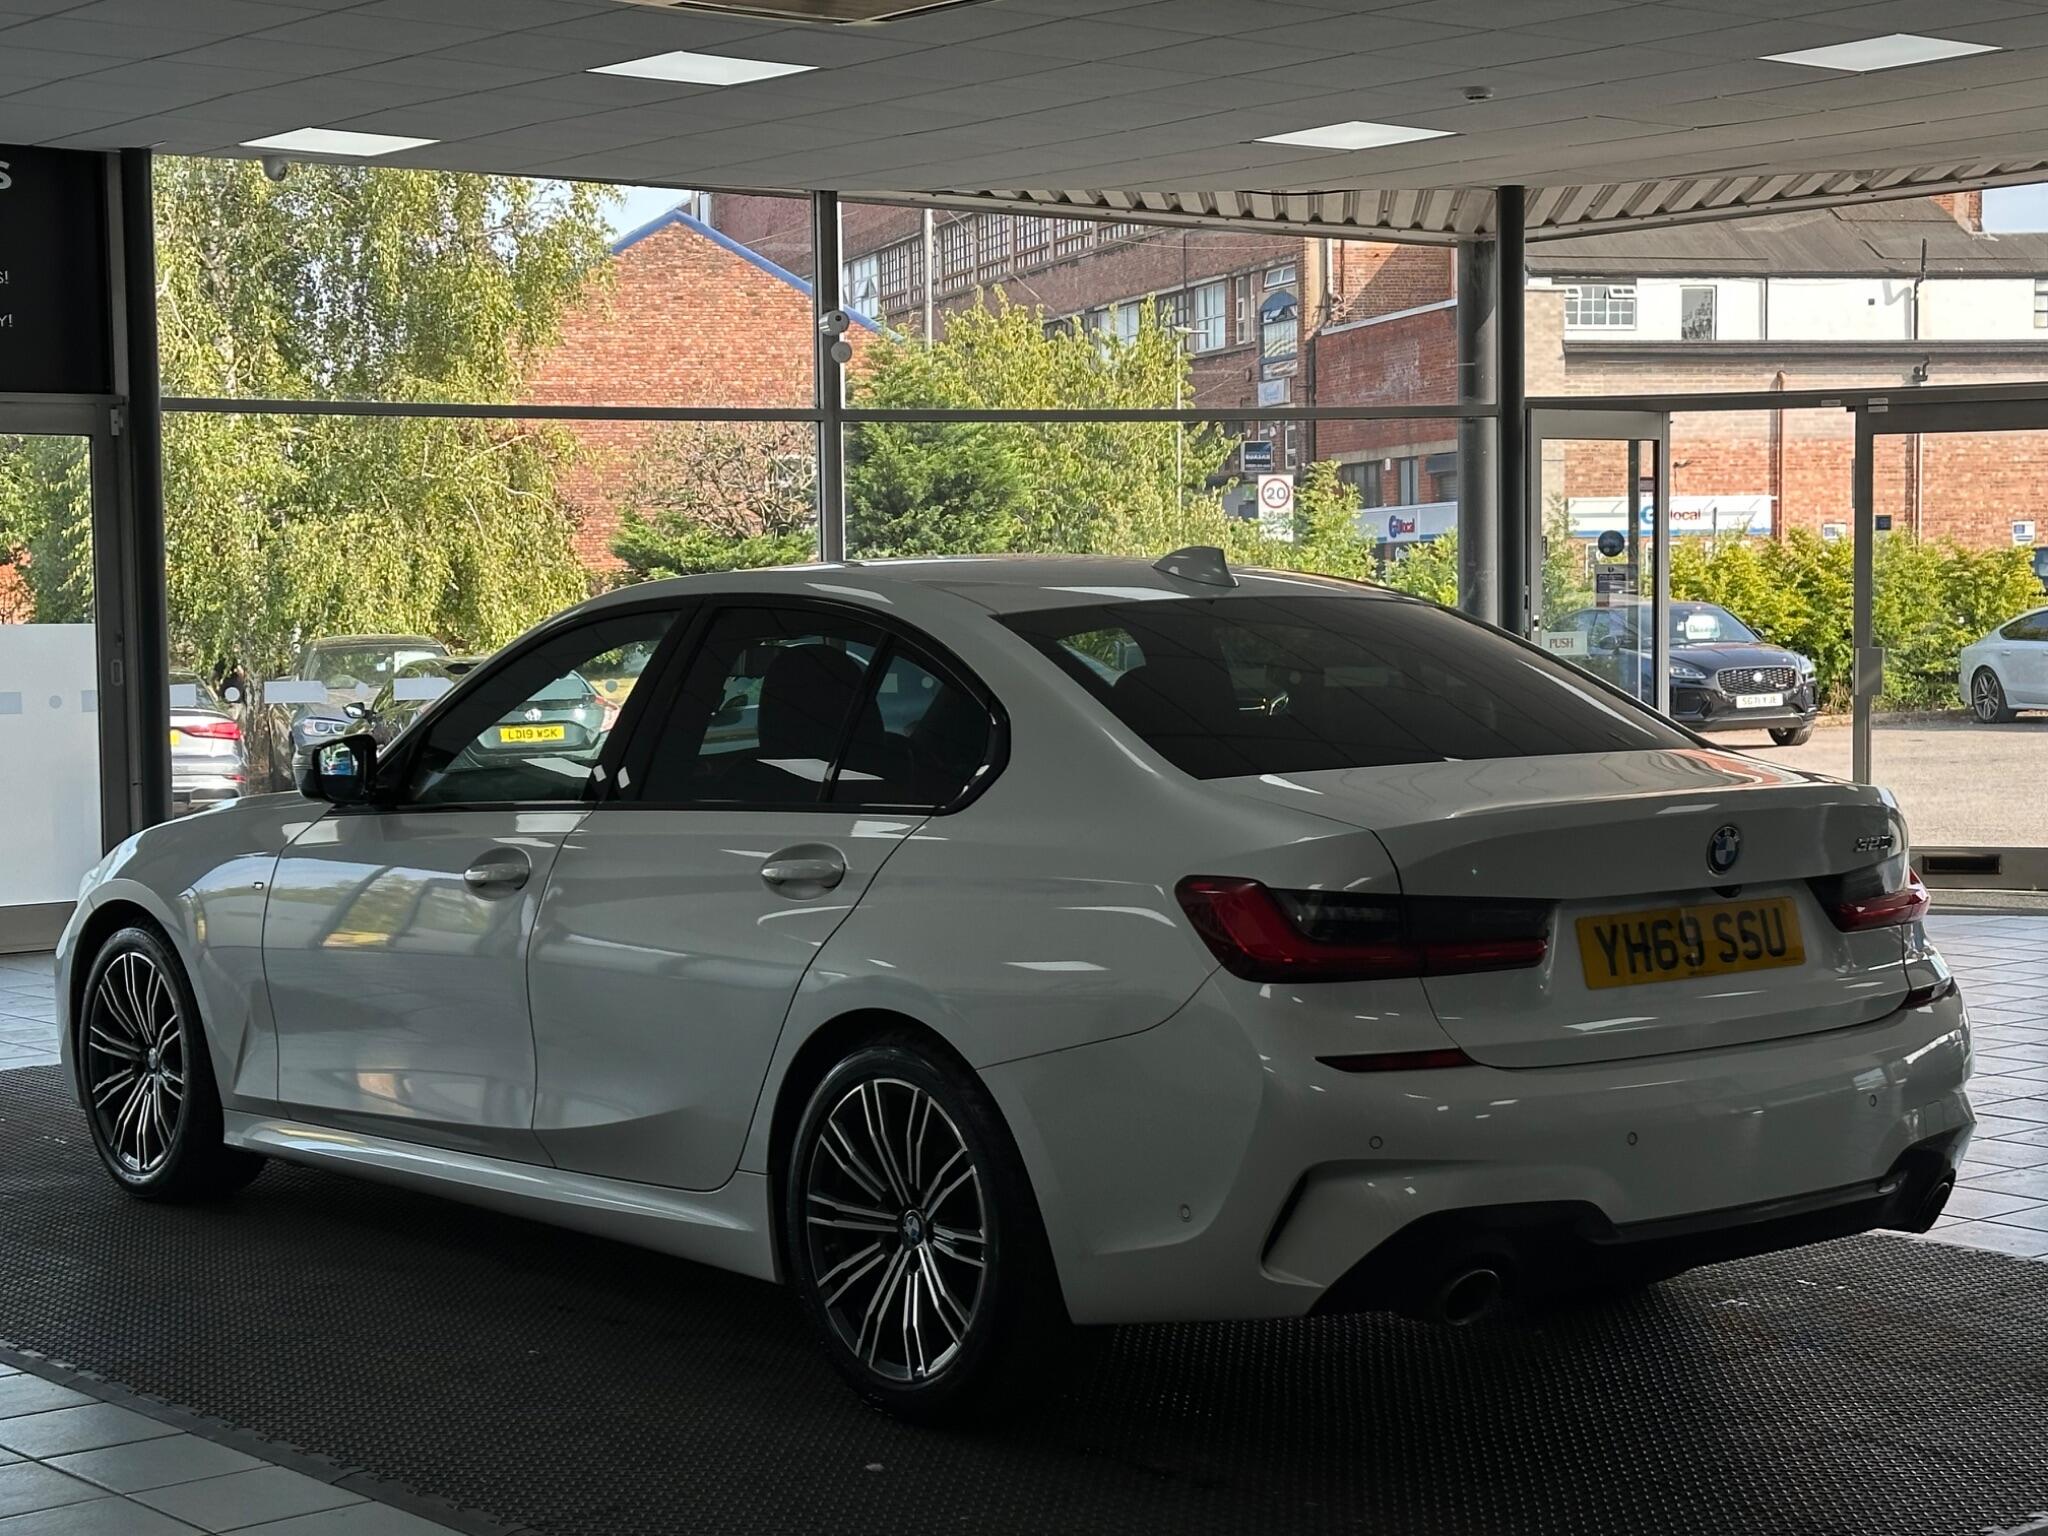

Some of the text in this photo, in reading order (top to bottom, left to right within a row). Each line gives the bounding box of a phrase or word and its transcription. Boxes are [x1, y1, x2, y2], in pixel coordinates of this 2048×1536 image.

[1266, 487, 1286, 500] 20
[1671, 508, 1700, 520] local
[1549, 638, 1573, 648] PUSH
[1594, 907, 1787, 977] YH69 SSU
